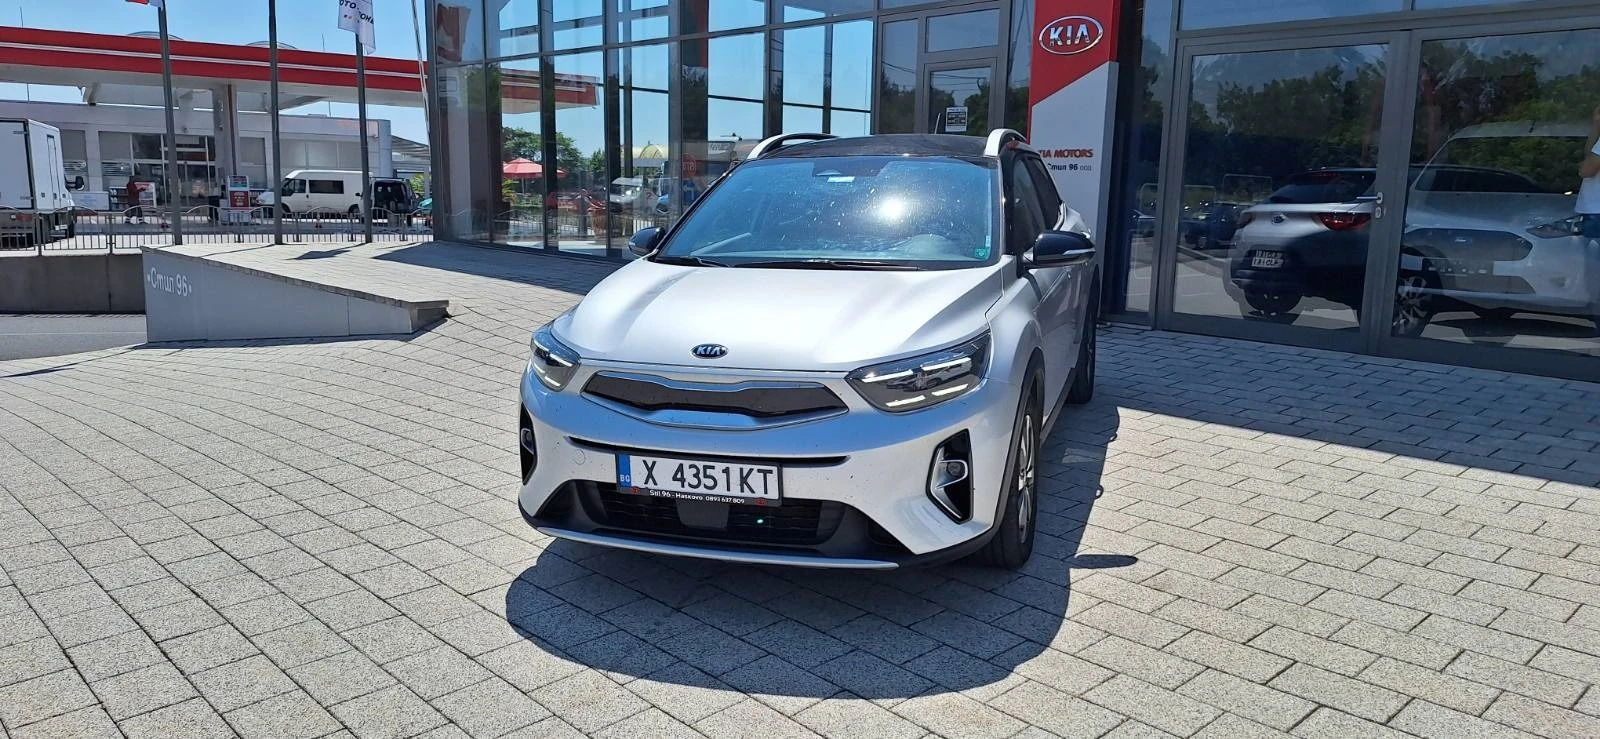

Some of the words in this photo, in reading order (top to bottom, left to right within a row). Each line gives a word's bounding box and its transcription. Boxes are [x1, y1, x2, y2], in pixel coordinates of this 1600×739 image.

[1049, 23, 1090, 46] KIA
[1054, 149, 1093, 158] MOTORS
[1069, 163, 1079, 171] 96
[176, 273, 188, 297] 96
[697, 346, 720, 355] KIA
[620, 474, 631, 483] BG
[642, 460, 658, 486] X
[649, 489, 661, 497] Stil
[662, 490, 671, 498] 96
[676, 492, 703, 501] Haskovo
